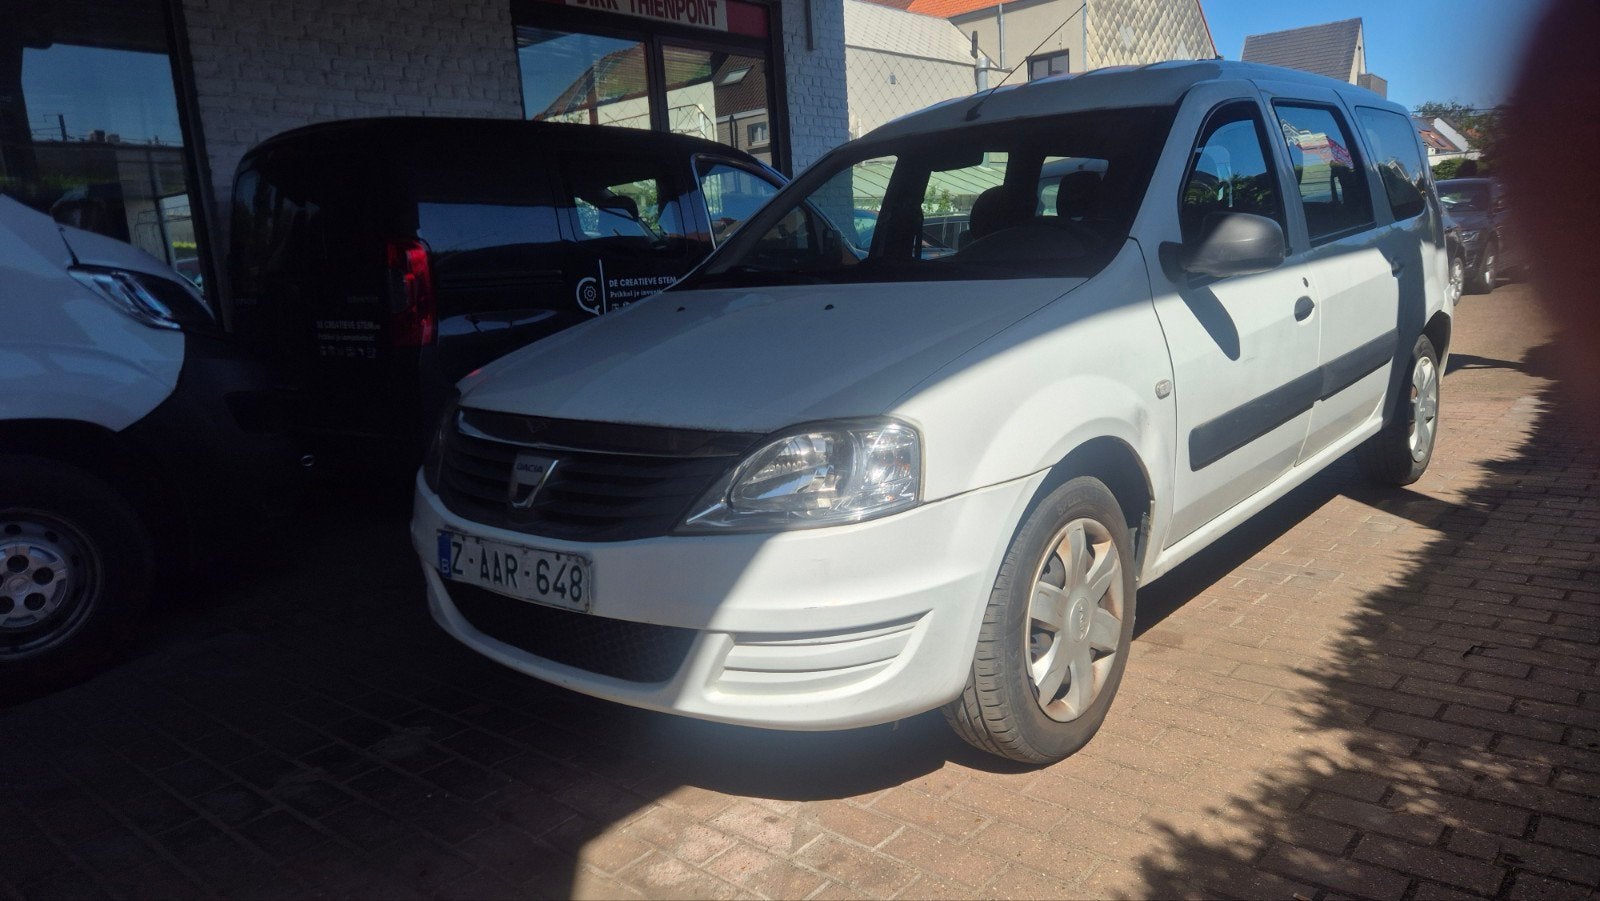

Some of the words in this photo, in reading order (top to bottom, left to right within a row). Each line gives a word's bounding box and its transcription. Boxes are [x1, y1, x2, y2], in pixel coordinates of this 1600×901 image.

[629, 0, 717, 26] THIENPONT
[609, 279, 618, 287] DE
[620, 278, 657, 287] CREATIEVE
[516, 462, 543, 473] DACIA
[441, 558, 449, 574] B
